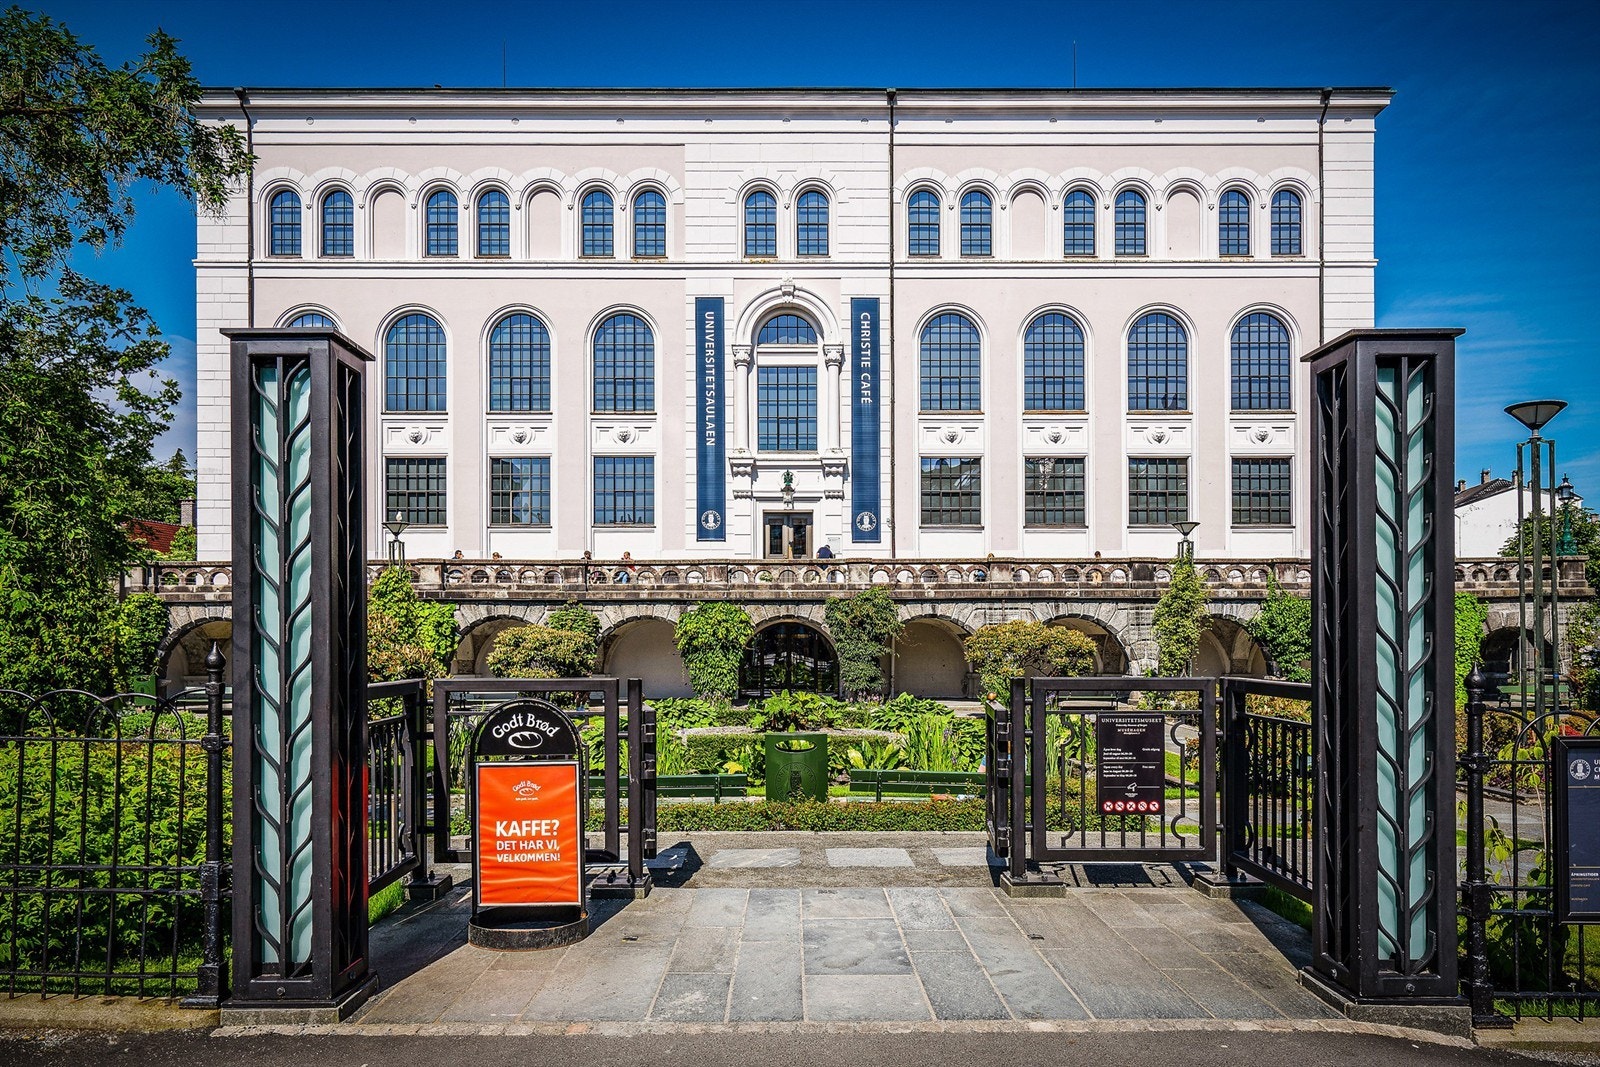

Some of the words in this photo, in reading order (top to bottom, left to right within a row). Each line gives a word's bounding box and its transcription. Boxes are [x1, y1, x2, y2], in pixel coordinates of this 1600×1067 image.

[860, 312, 871, 368] CHRISTIE
[704, 311, 715, 446] UNIVERSITETSAULAEN
[861, 373, 873, 404] CAFÉ
[492, 713, 524, 738] Godt
[526, 713, 560, 737] Brød
[495, 819, 560, 837] KAFFE?
[496, 840, 517, 851] DET
[519, 840, 544, 850] HAR
[545, 839, 560, 851] VI,
[496, 853, 560, 863] VELKOMMEN!
